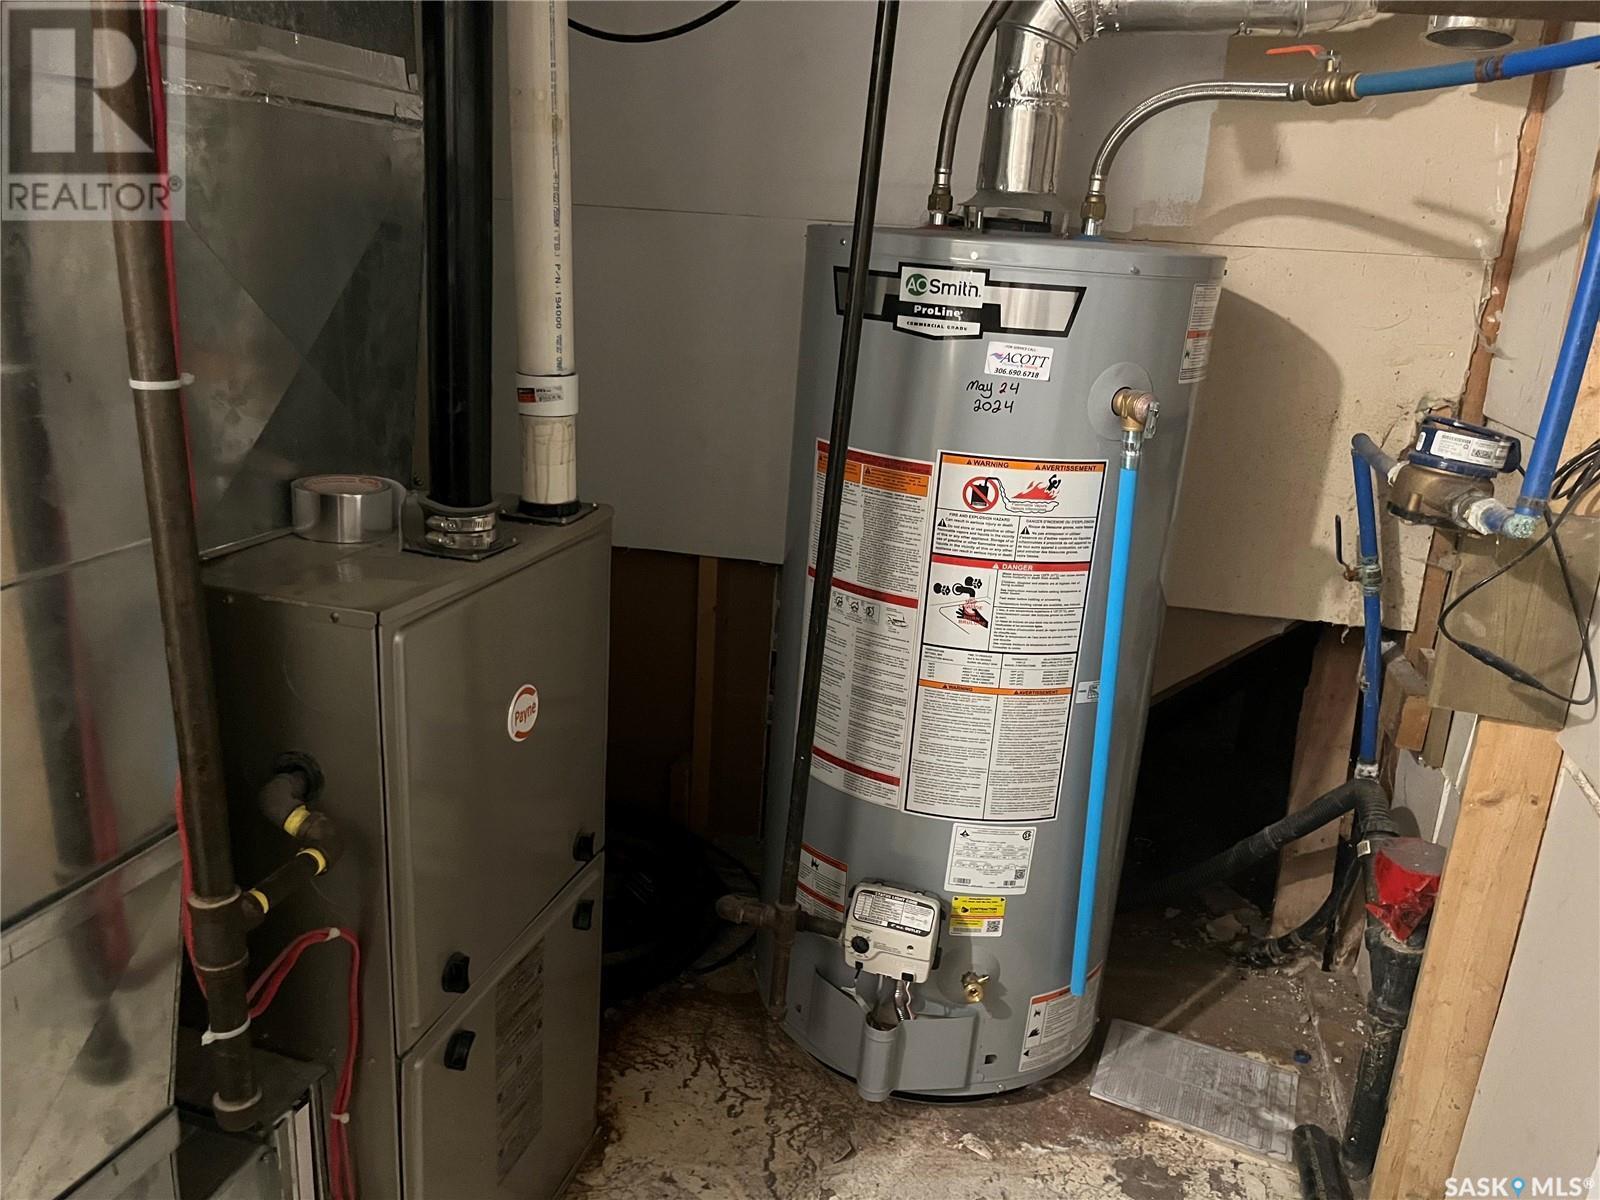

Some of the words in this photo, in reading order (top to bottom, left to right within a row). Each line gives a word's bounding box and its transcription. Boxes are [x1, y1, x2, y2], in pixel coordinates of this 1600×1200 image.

[906, 320, 944, 329] COMMERCIAL
[1000, 352, 1050, 368] ACOTT
[994, 368, 1040, 378] 306.690.6718
[966, 380, 993, 398] May
[1000, 382, 1020, 394] 24
[974, 399, 1014, 413] 2024
[974, 460, 1009, 468] WARNING
[514, 702, 536, 726] Payne
